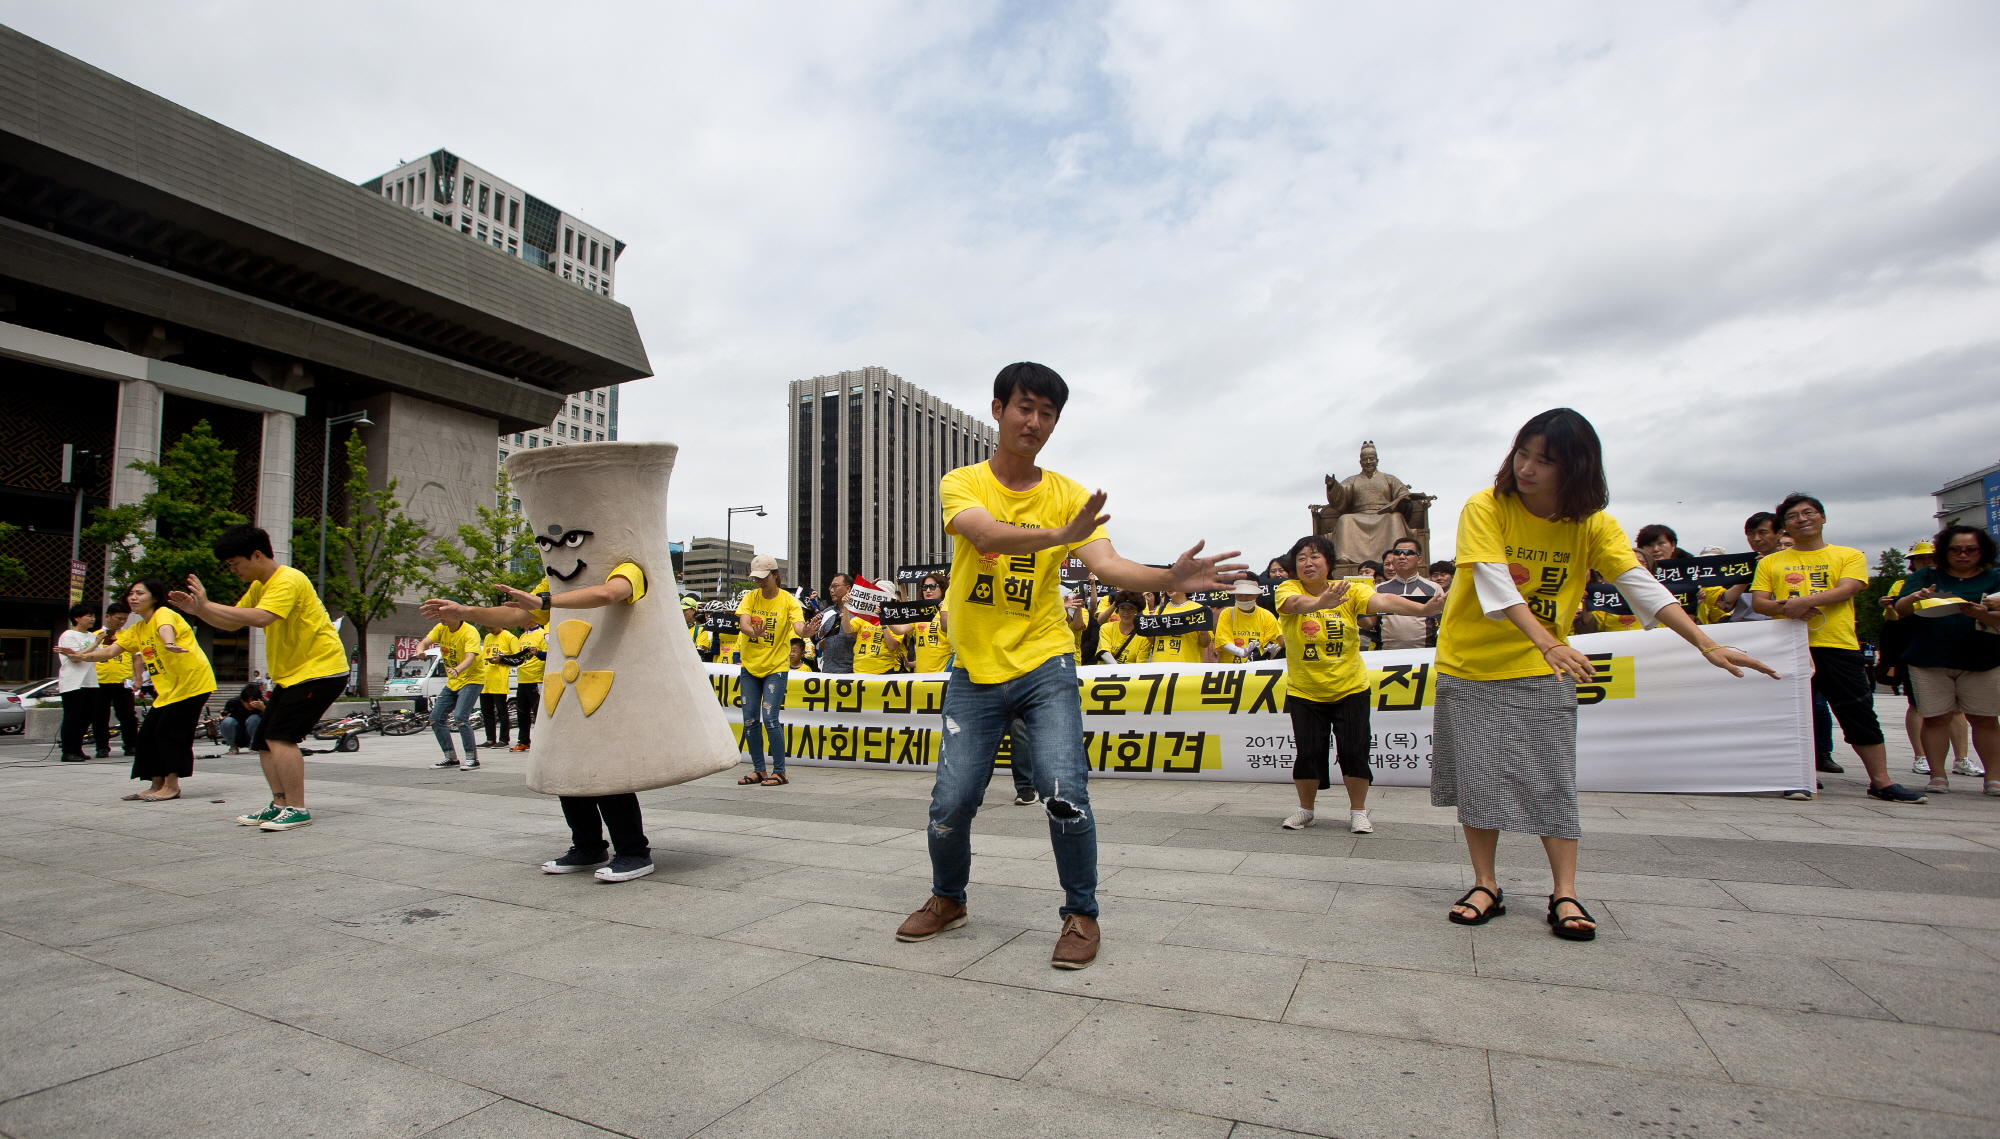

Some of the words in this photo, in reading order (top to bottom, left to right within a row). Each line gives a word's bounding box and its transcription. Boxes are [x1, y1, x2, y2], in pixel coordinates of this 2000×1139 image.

[1070, 559, 1086, 567] 전환
[1517, 547, 1548, 562] 터지기
[1553, 551, 1571, 564] 전에
[1654, 567, 1683, 582] 원전
[1687, 566, 1716, 581] 말고
[1720, 562, 1753, 576] 안전
[1258, 584, 1270, 596] 전
[849, 598, 877, 612] 지화하
[1593, 591, 1622, 607] 원전
[1678, 592, 1689, 607] 전
[1162, 616, 1184, 629] 말고
[1186, 612, 1207, 625] 안전
[802, 678, 865, 713] 위한
[881, 680, 949, 714] 신고
[1200, 669, 1291, 715] 백지
[1377, 663, 1430, 712] 전
[1385, 732, 1417, 750] (목)
[1424, 734, 1432, 746] 1
[1083, 730, 1206, 773] 자회견
[1246, 754, 1298, 769] 광화문
[1369, 753, 1420, 769] 대왕상
